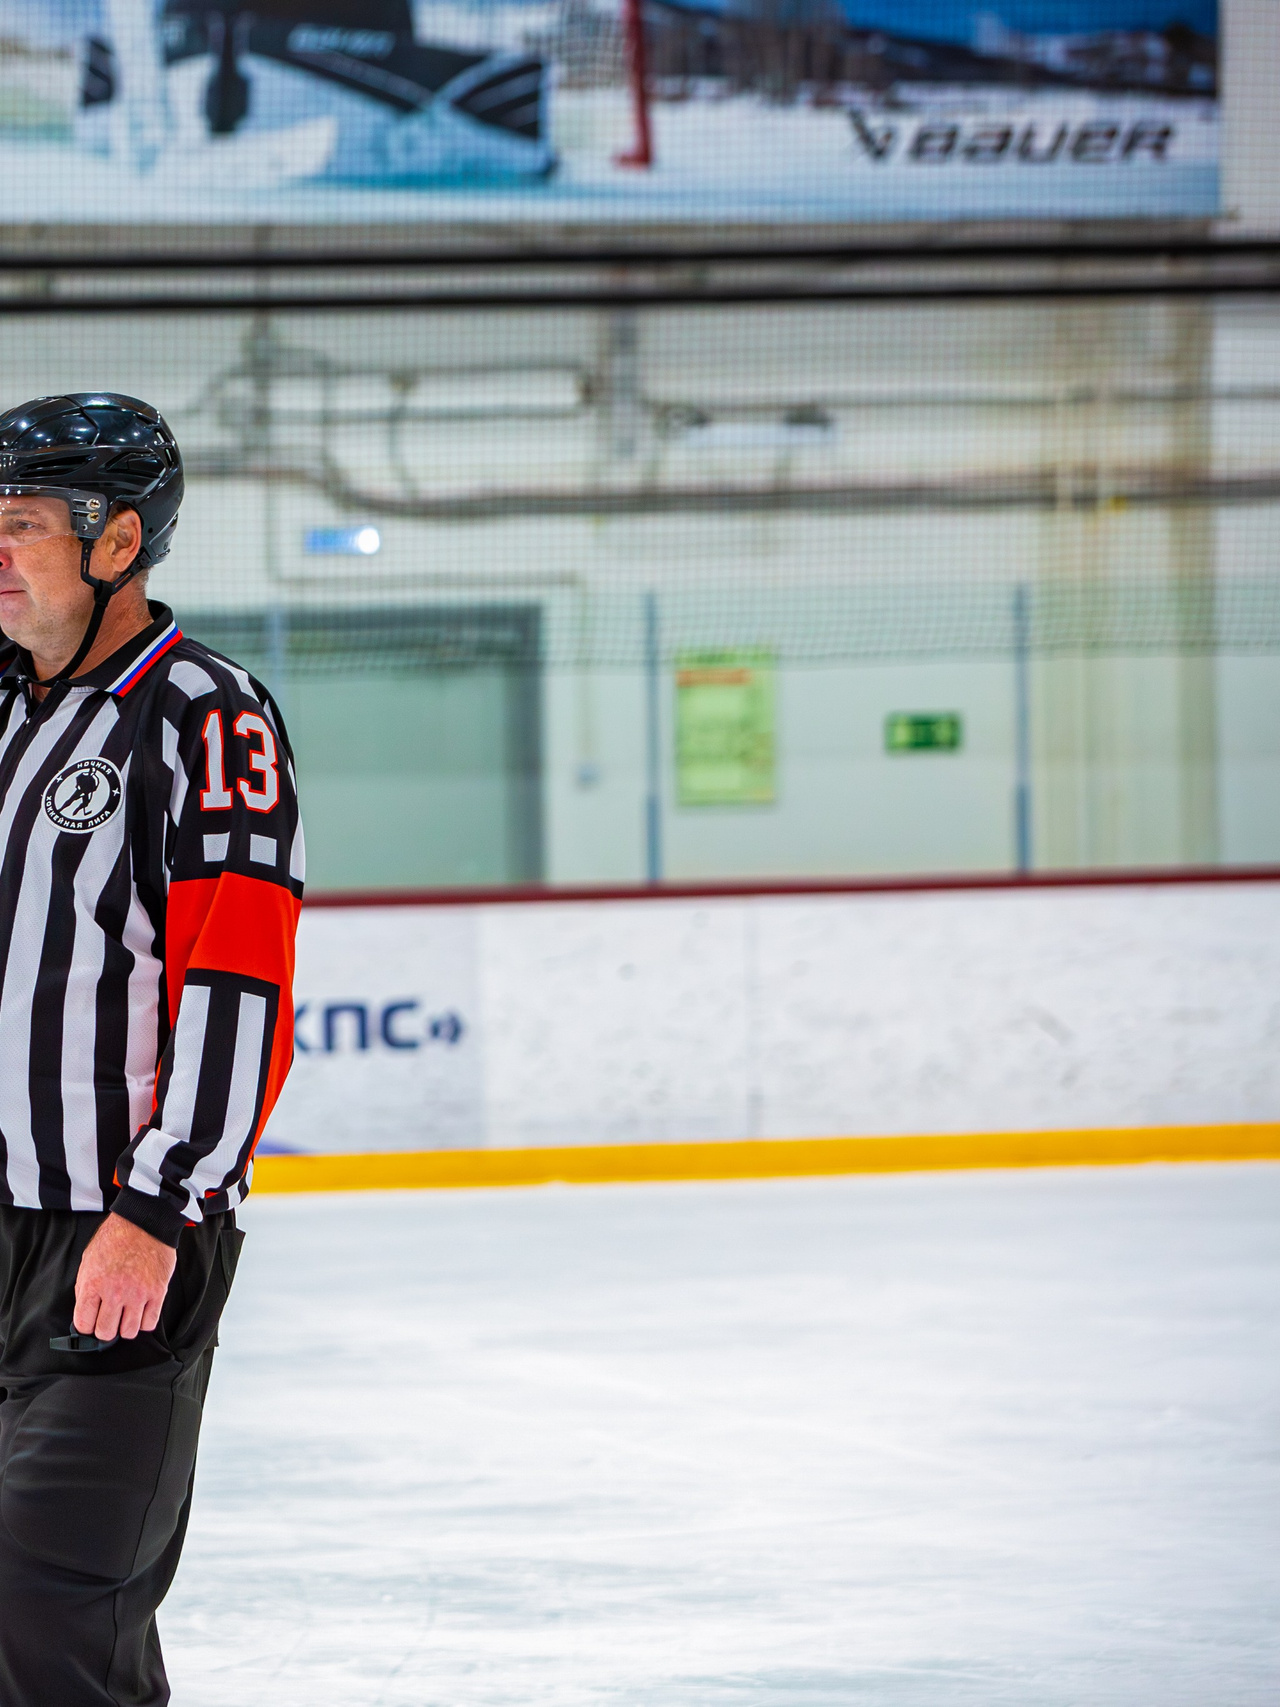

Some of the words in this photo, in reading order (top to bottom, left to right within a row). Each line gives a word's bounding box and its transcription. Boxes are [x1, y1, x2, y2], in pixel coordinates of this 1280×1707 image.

[76, 760, 113, 775] НОЧНАЯ
[200, 709, 280, 814] 13
[45, 795, 83, 828] ХОККЕЙНАЯ
[87, 810, 111, 828] ЛИГА
